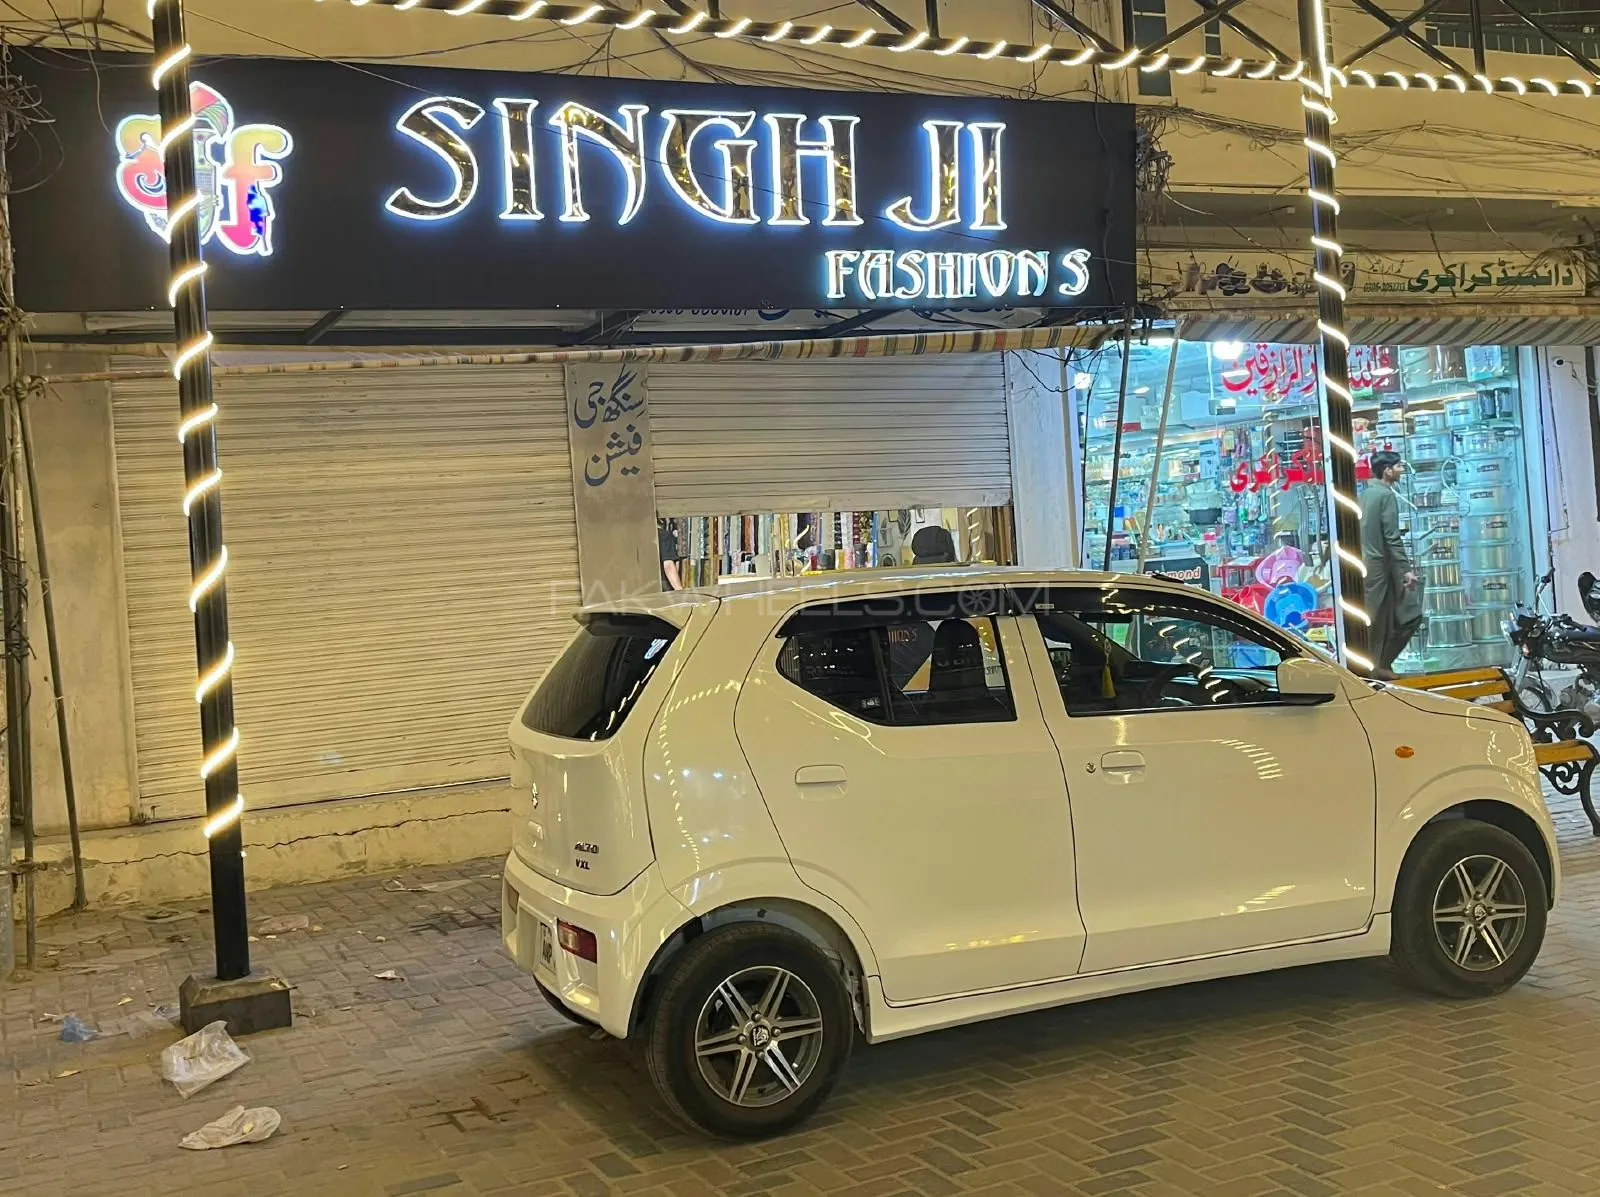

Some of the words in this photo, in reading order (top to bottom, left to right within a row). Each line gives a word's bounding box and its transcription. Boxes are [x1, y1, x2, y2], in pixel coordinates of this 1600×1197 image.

[385, 96, 864, 226] SINGH
[885, 120, 1007, 231] JI
[585, 424, 642, 487] فیشن
